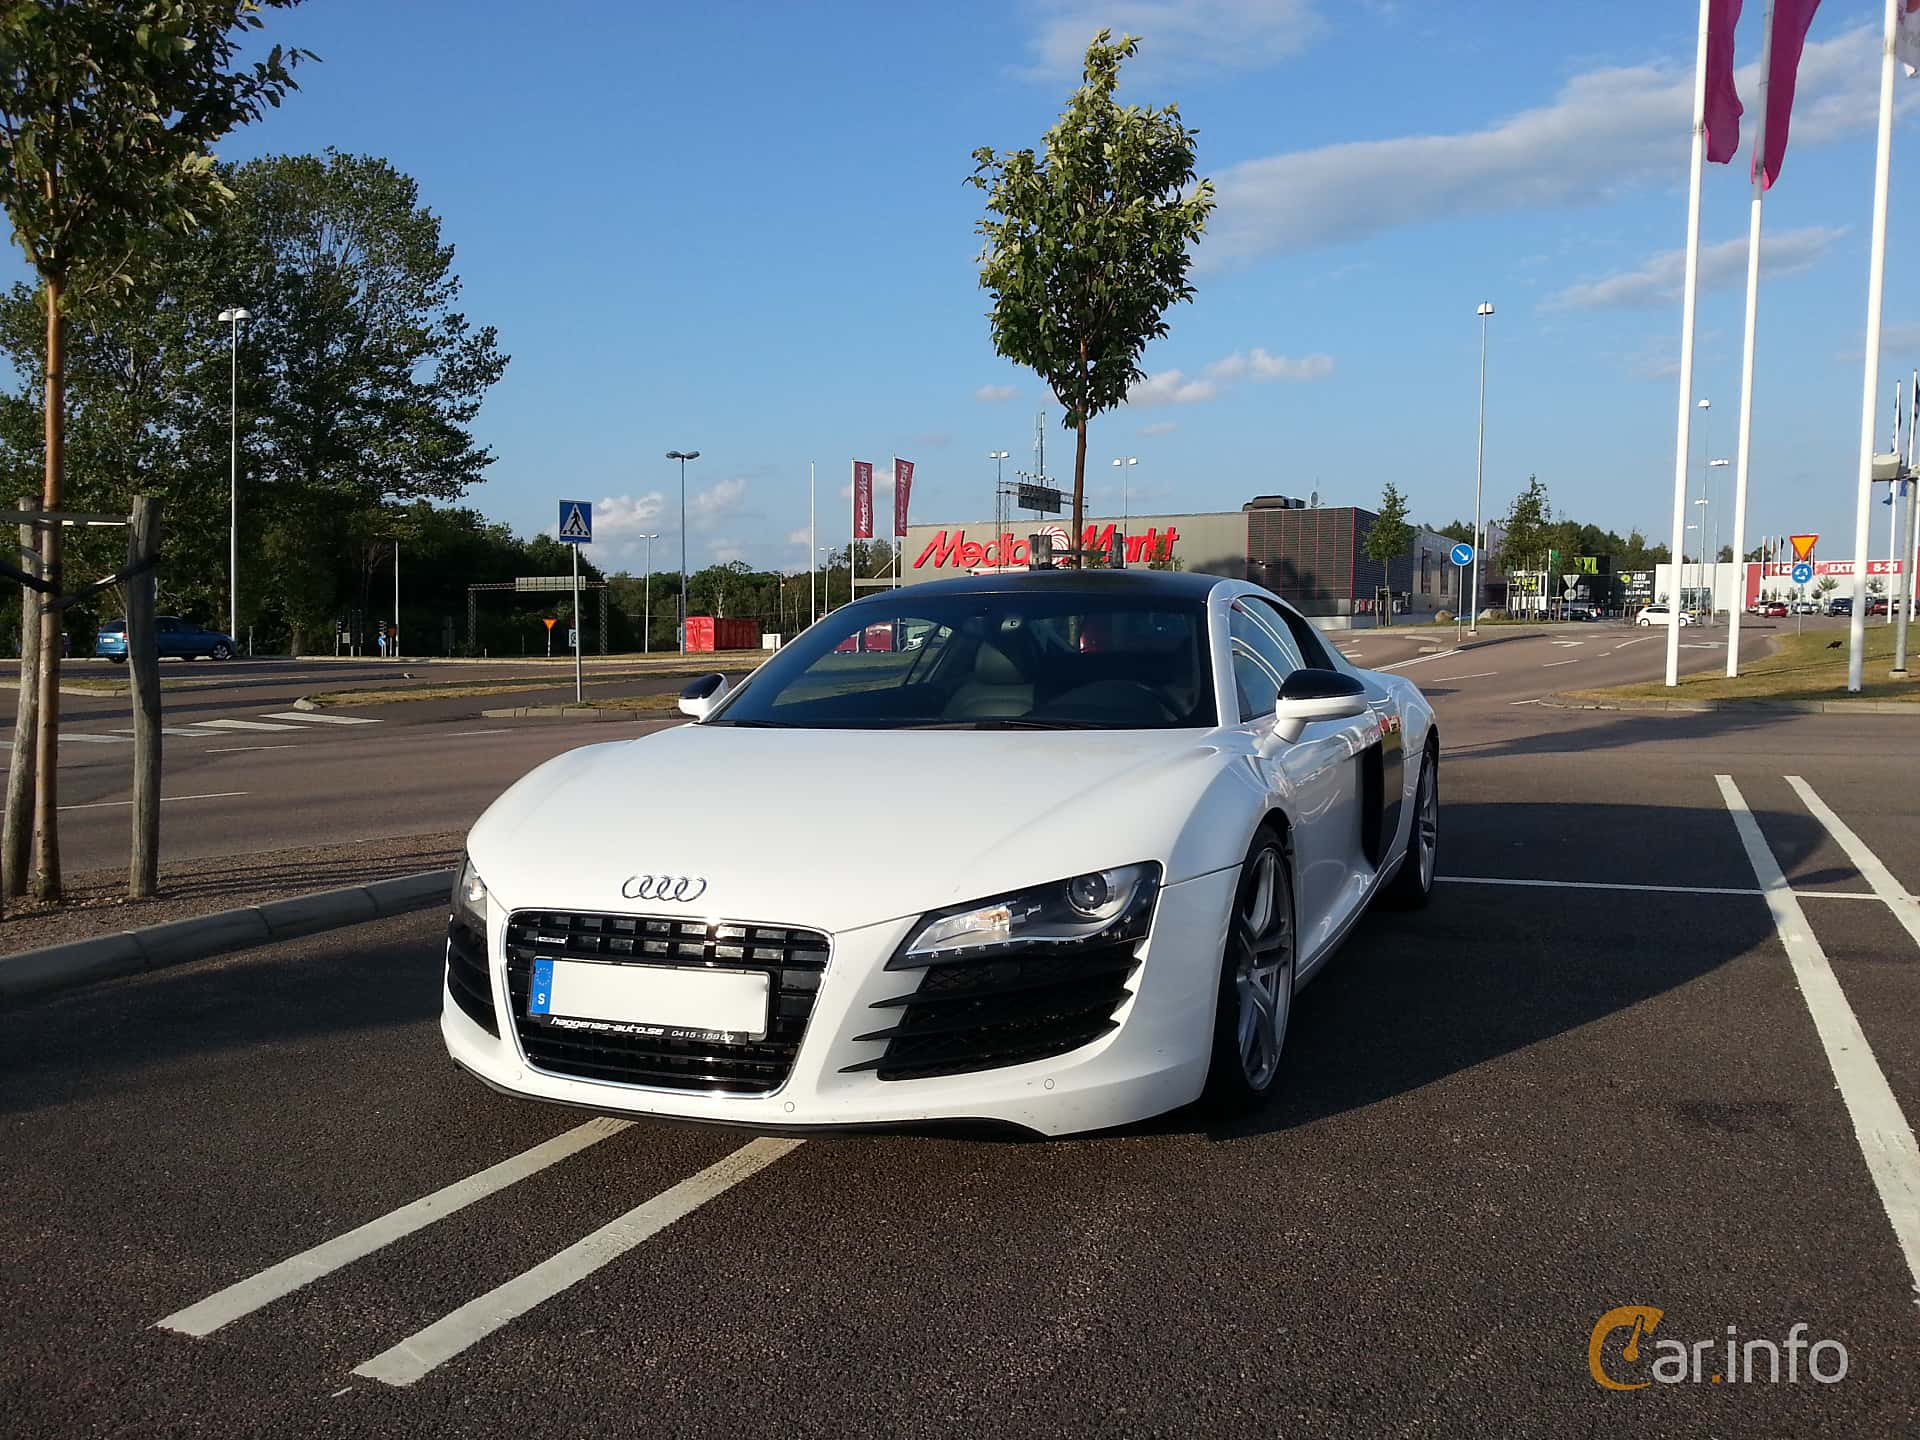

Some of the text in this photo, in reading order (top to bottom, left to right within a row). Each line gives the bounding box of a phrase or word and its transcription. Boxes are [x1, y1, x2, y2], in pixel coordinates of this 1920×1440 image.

[913, 523, 1180, 568] Media Mrkt
[537, 993, 546, 1006] S
